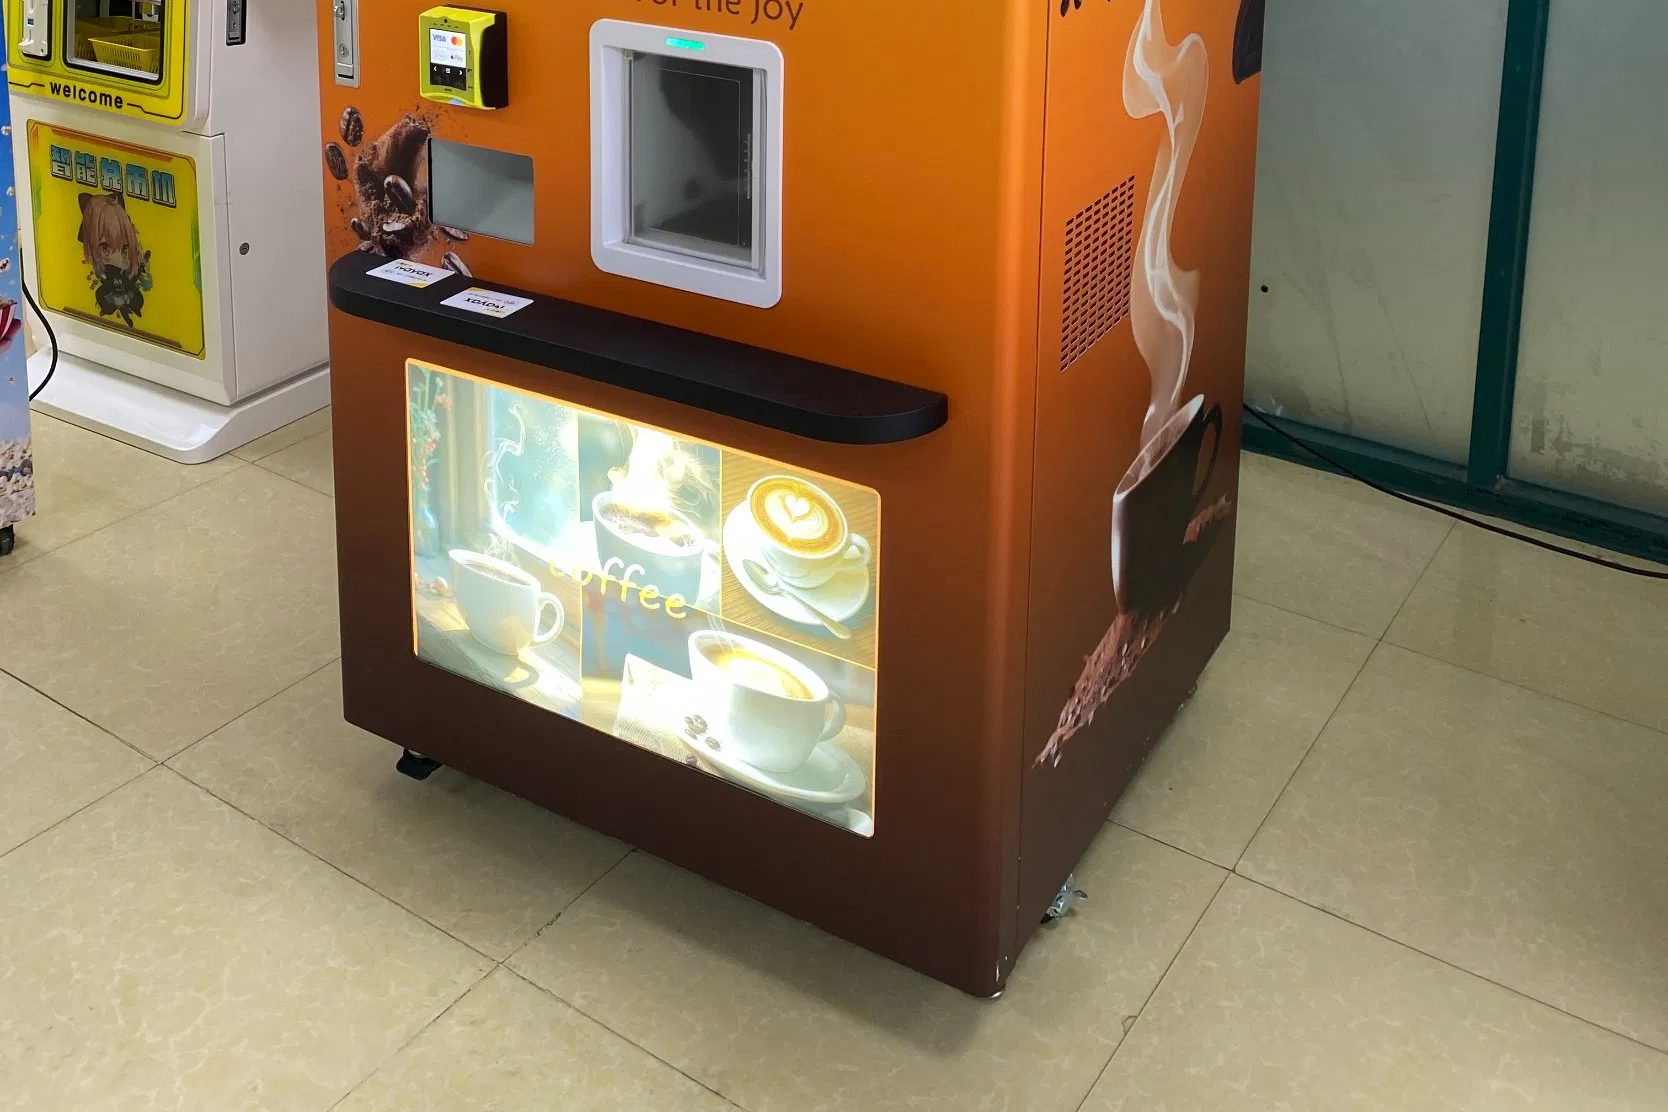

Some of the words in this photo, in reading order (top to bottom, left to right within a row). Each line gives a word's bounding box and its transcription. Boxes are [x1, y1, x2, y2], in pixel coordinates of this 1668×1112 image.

[432, 34, 446, 42] VISA
[50, 82, 123, 109] welcome
[50, 144, 176, 208] 智能兑币机
[550, 556, 687, 619] coffee
